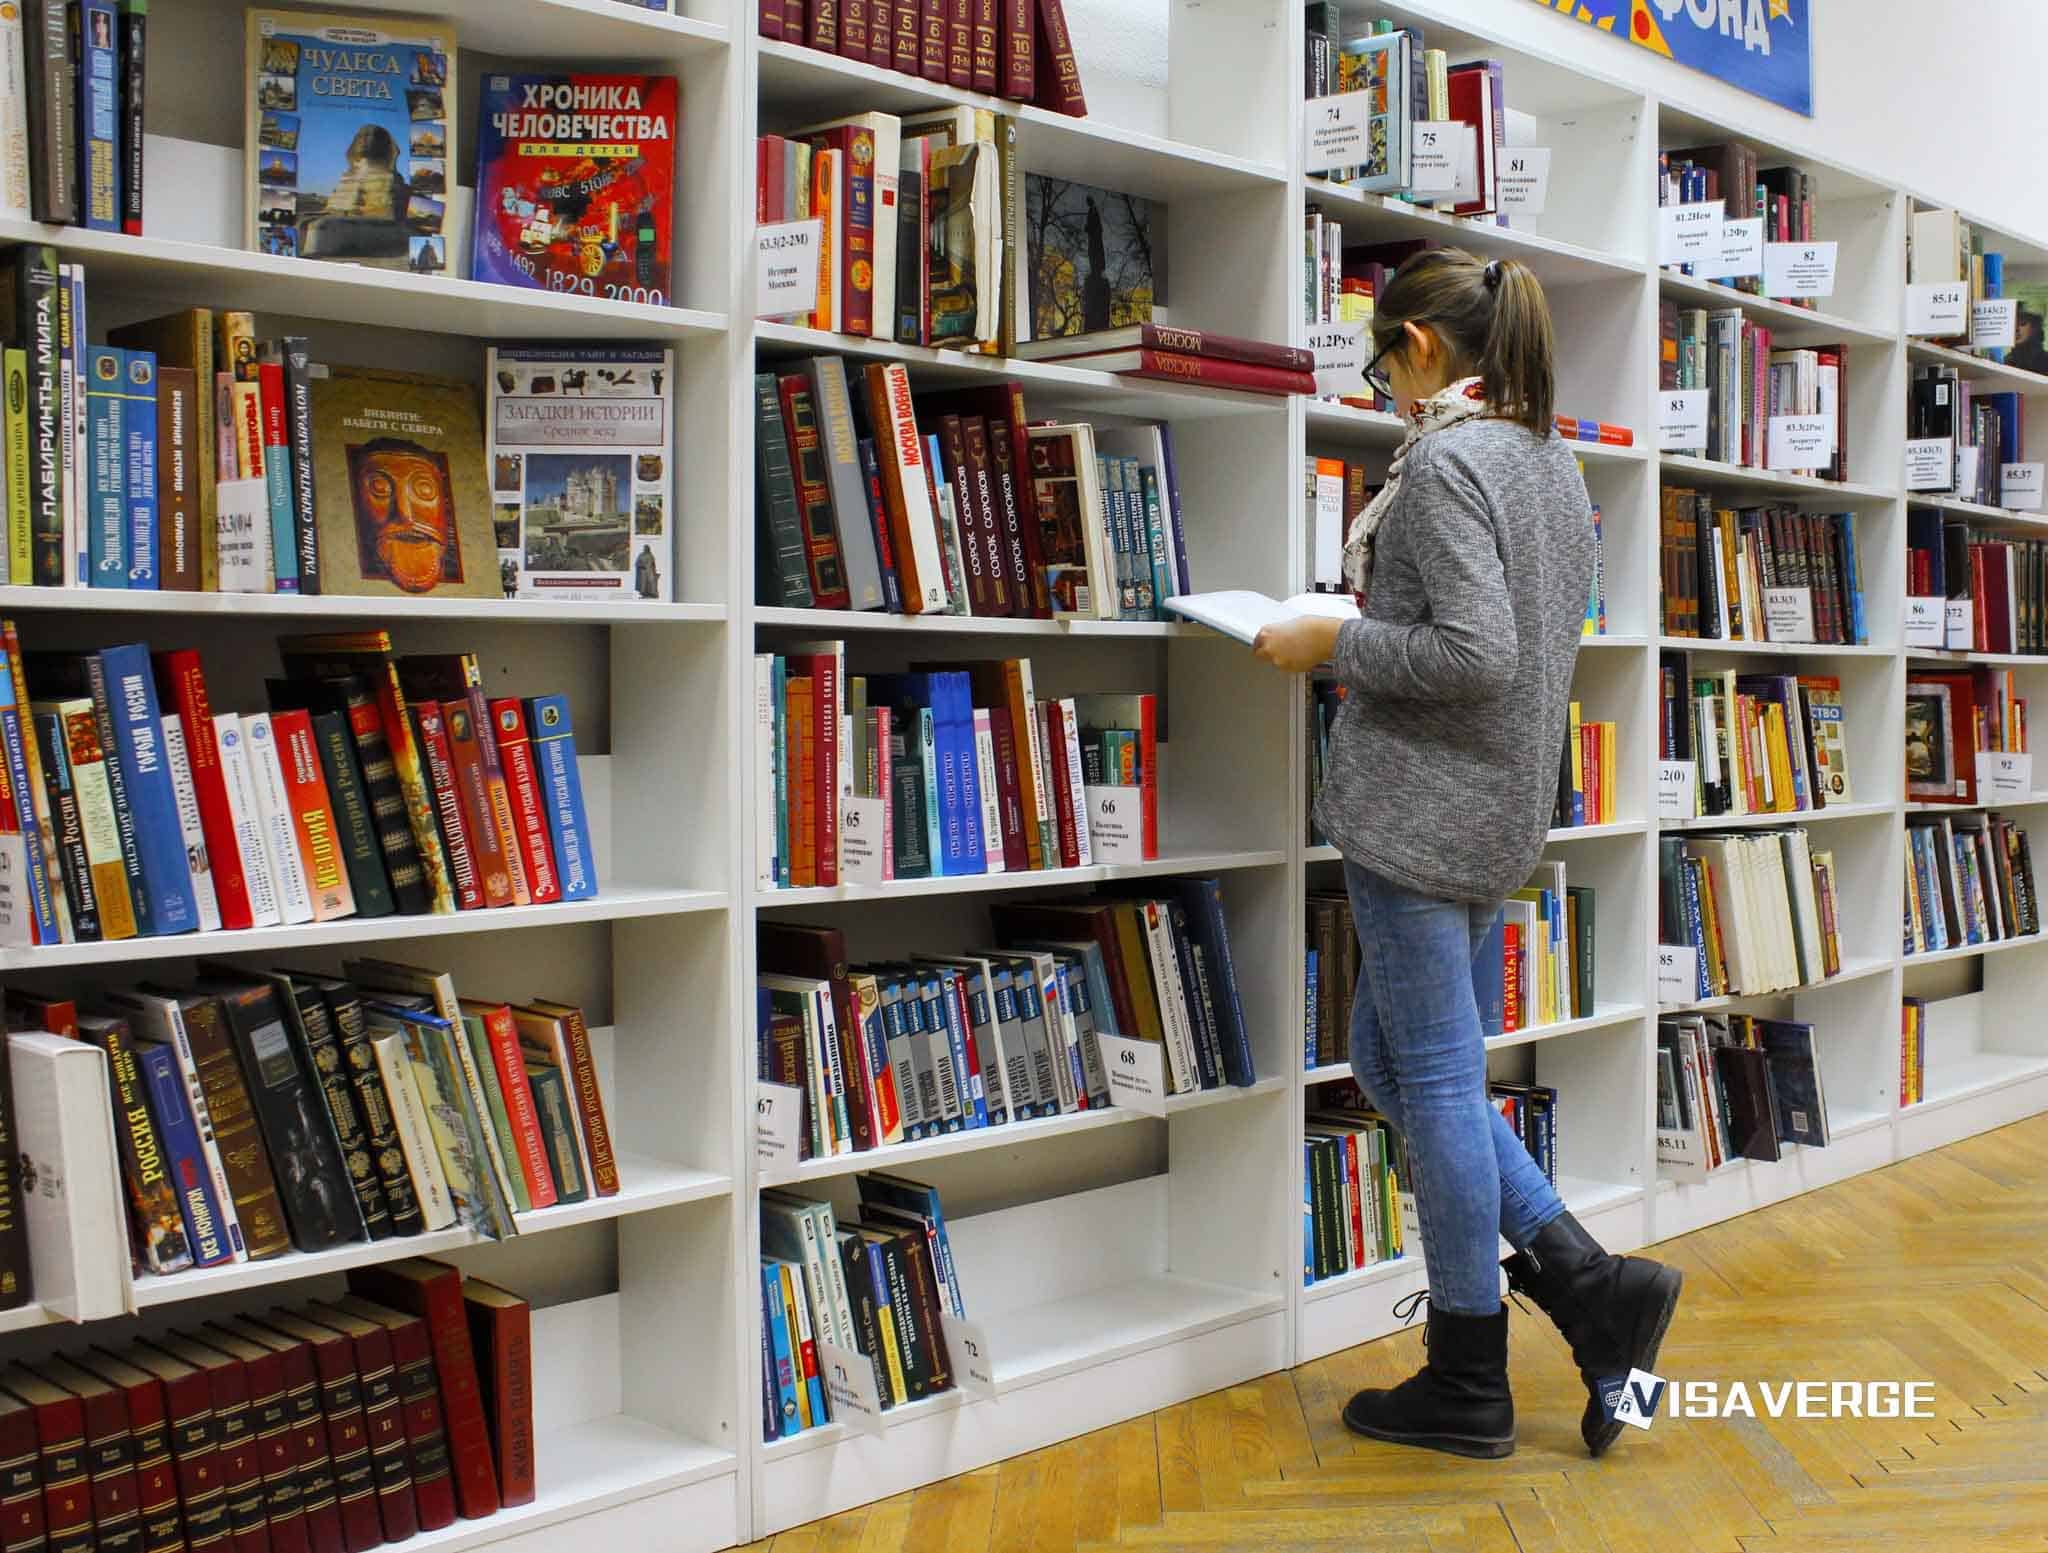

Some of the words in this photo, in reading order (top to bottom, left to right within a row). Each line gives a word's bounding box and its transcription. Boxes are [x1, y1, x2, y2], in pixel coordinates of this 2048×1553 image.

[982, 33, 991, 47] 9
[1014, 39, 1030, 54] 10
[304, 48, 401, 75] ЧУДЕСА
[312, 76, 393, 100] СВЕТА
[523, 84, 642, 110] ХРОНИКА
[493, 114, 669, 140] ЧЕЛОВЕЧЕСТВА
[1327, 107, 1341, 121] 74
[524, 145, 560, 155] ДЛЯ
[576, 146, 635, 156] ДЕТЕЙ
[1422, 132, 1437, 147] 75
[1511, 159, 1525, 171] 81
[1803, 250, 1815, 261] 82
[36, 295, 54, 364] МИРА
[1308, 333, 1355, 350] 81.2Рус
[888, 368, 912, 418] ВОЕННАЯ
[1670, 400, 1684, 412] 83
[504, 404, 574, 421] ЗАГАДКИ
[580, 405, 655, 421] ИСТОРИИ
[38, 371, 58, 517] ЛАБИРИНТЫ
[898, 421, 921, 466] МОСКВА
[957, 465, 974, 526] СОРОКОВ
[977, 470, 994, 529] СОРОКОВ
[1001, 473, 1018, 532] СОРОКОВ
[1149, 503, 1162, 531] МИР
[967, 531, 983, 576] СОРОК
[986, 534, 1002, 578] СОРОК
[1010, 537, 1026, 582] СОРОК
[1152, 533, 1167, 566] ВЕСЬ
[122, 674, 149, 721] РОССИИ
[329, 732, 353, 787] России
[846, 811, 860, 828] 65
[1101, 799, 1116, 815] 66
[1659, 954, 1673, 966] 85
[1695, 926, 1711, 992] ИСКУССТВО
[826, 1023, 843, 1095] ПРИЗЫВНИКА
[1120, 1049, 1136, 1065] 68
[578, 1064, 602, 1112] РУССКОЙ
[758, 1099, 774, 1115] 67
[127, 1104, 164, 1184] РОССИЯ
[185, 1188, 214, 1238] МОНАРХИ
[202, 1237, 221, 1261] ВСЕ
[965, 1340, 979, 1357] 72
